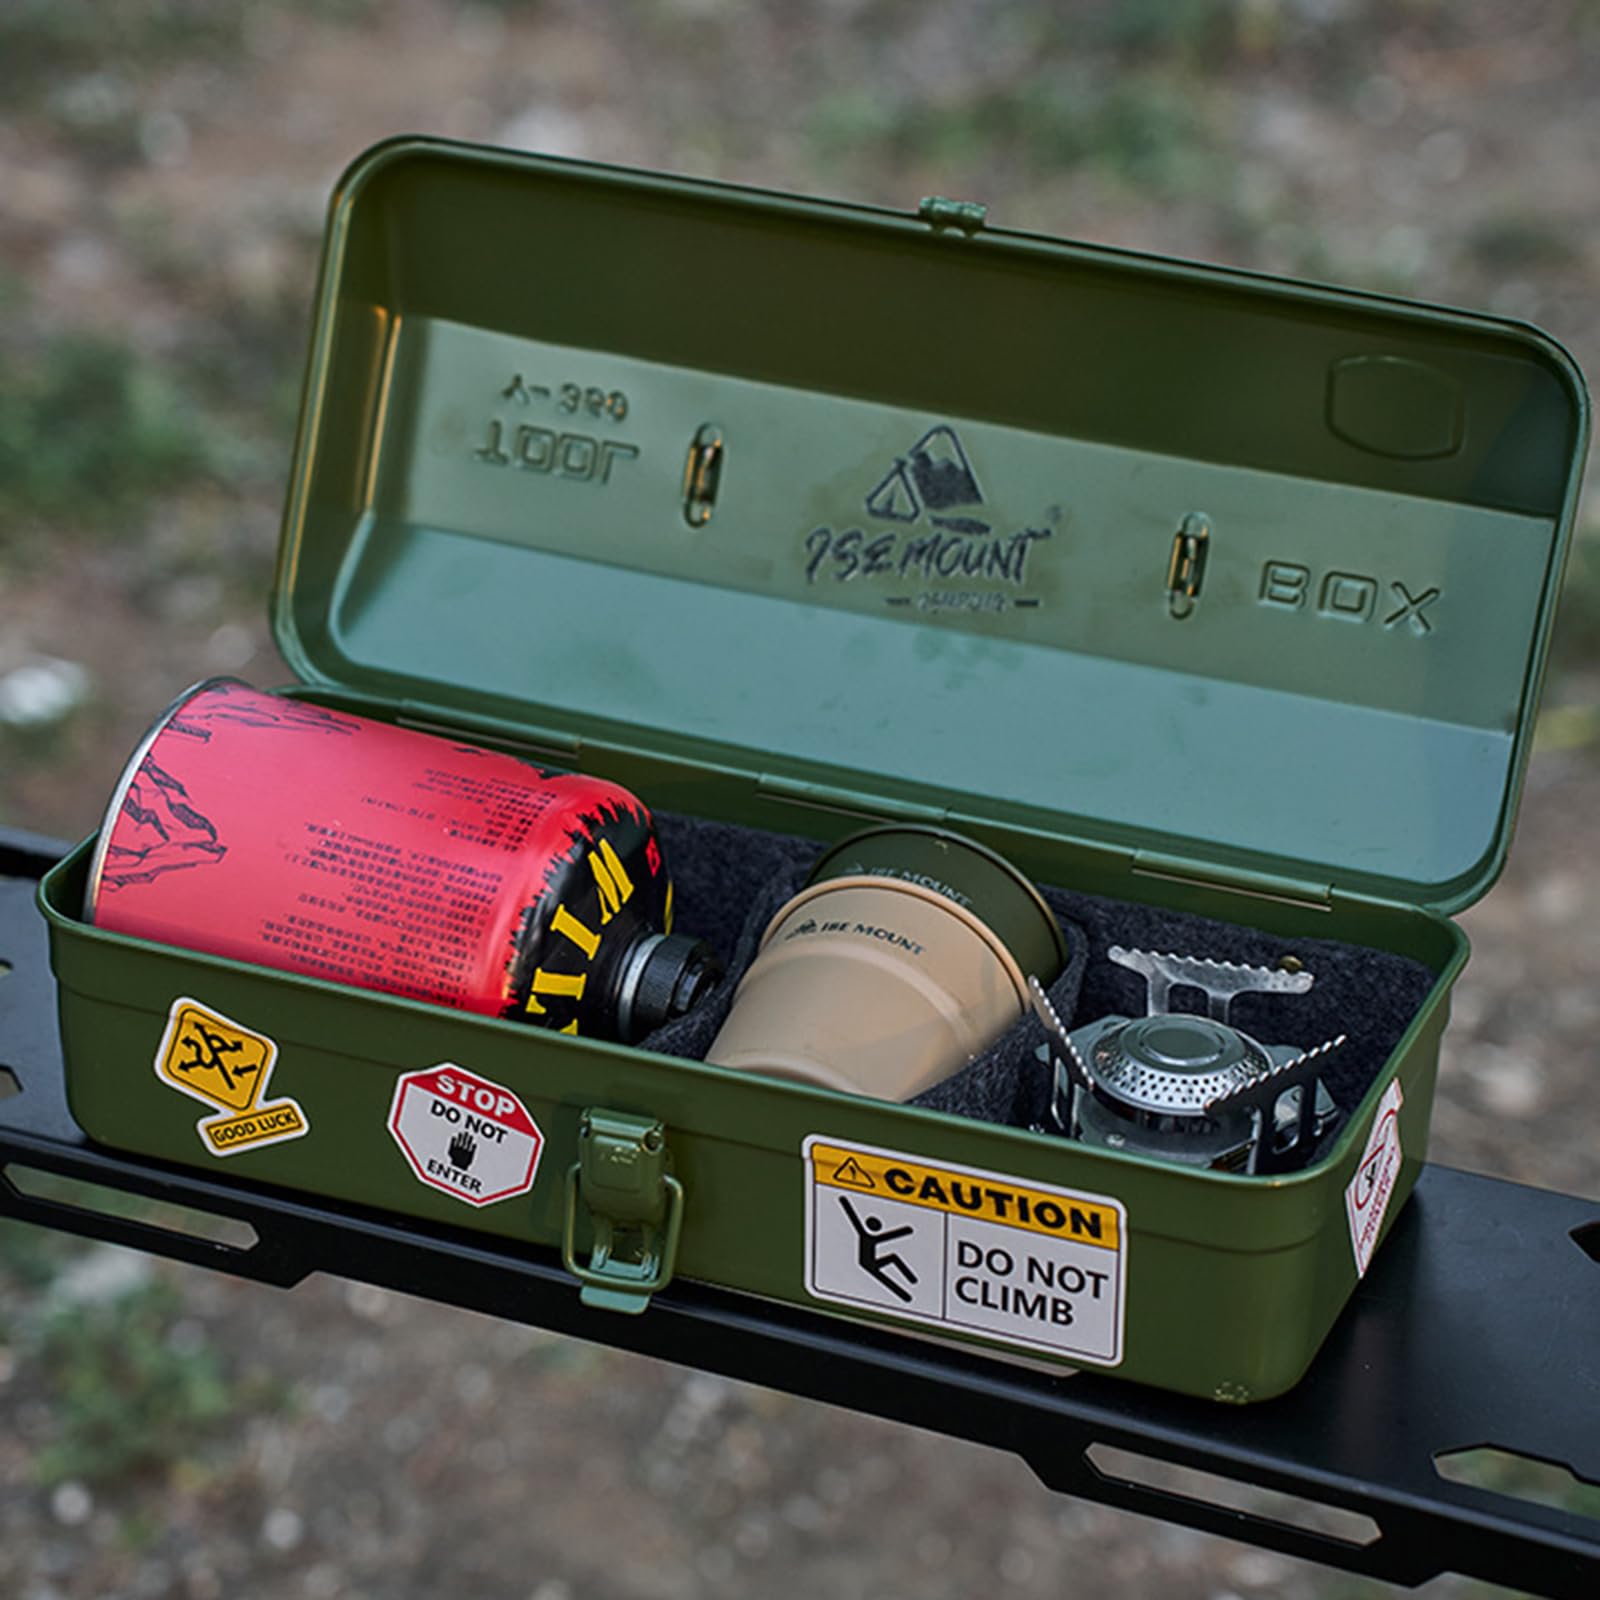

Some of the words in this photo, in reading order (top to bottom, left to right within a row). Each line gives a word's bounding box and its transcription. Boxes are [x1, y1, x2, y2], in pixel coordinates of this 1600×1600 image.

[899, 527, 1052, 584] MOUNT
[1258, 559, 1441, 637] BOX
[525, 837, 635, 1036] WIL
[854, 923, 926, 955] MOUNT
[436, 1073, 516, 1118] STOP
[213, 1119, 257, 1143] GOOD
[258, 1107, 297, 1132] LUCK
[430, 1099, 461, 1125] DO
[464, 1112, 508, 1145] NOT
[427, 1158, 483, 1194] ENTER
[883, 1167, 1103, 1239] CAUTION
[957, 1239, 1014, 1277] DO
[1027, 1256, 1109, 1300] NOT
[954, 1275, 1074, 1326] CLIMB
